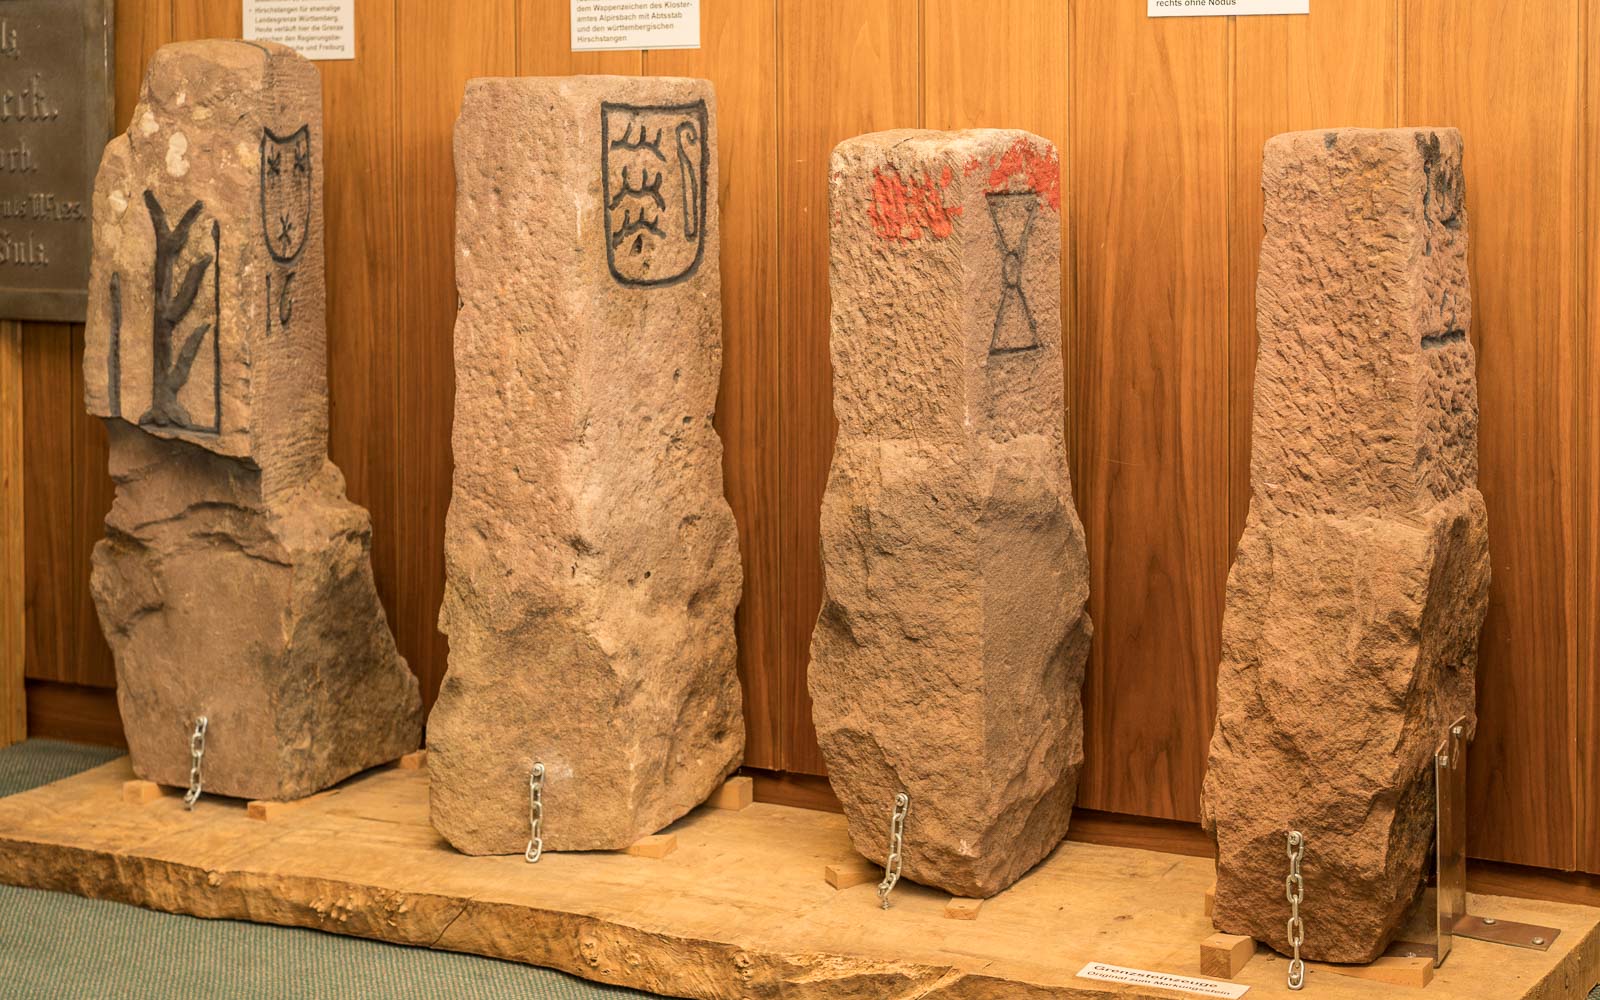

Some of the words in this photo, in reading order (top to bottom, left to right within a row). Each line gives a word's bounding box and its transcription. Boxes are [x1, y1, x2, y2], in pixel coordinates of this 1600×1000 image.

[594, 4, 648, 13] Wappenzeichen
[664, 1, 693, 9] Kloster-
[599, 13, 637, 23] Alpirsbach
[576, 25, 591, 33] und
[592, 24, 605, 32] den
[607, 23, 674, 32] württembergischen
[297, 34, 341, 42] Regierungsbe-
[577, 35, 627, 43] Hirschstangen
[318, 44, 345, 52] Freiburg
[0, 72, 58, 122] eck.
[1094, 965, 1218, 988] Grenzsteinzeuge
[1087, 971, 1127, 981] Original
[1153, 981, 1231, 996] Markungsstein
